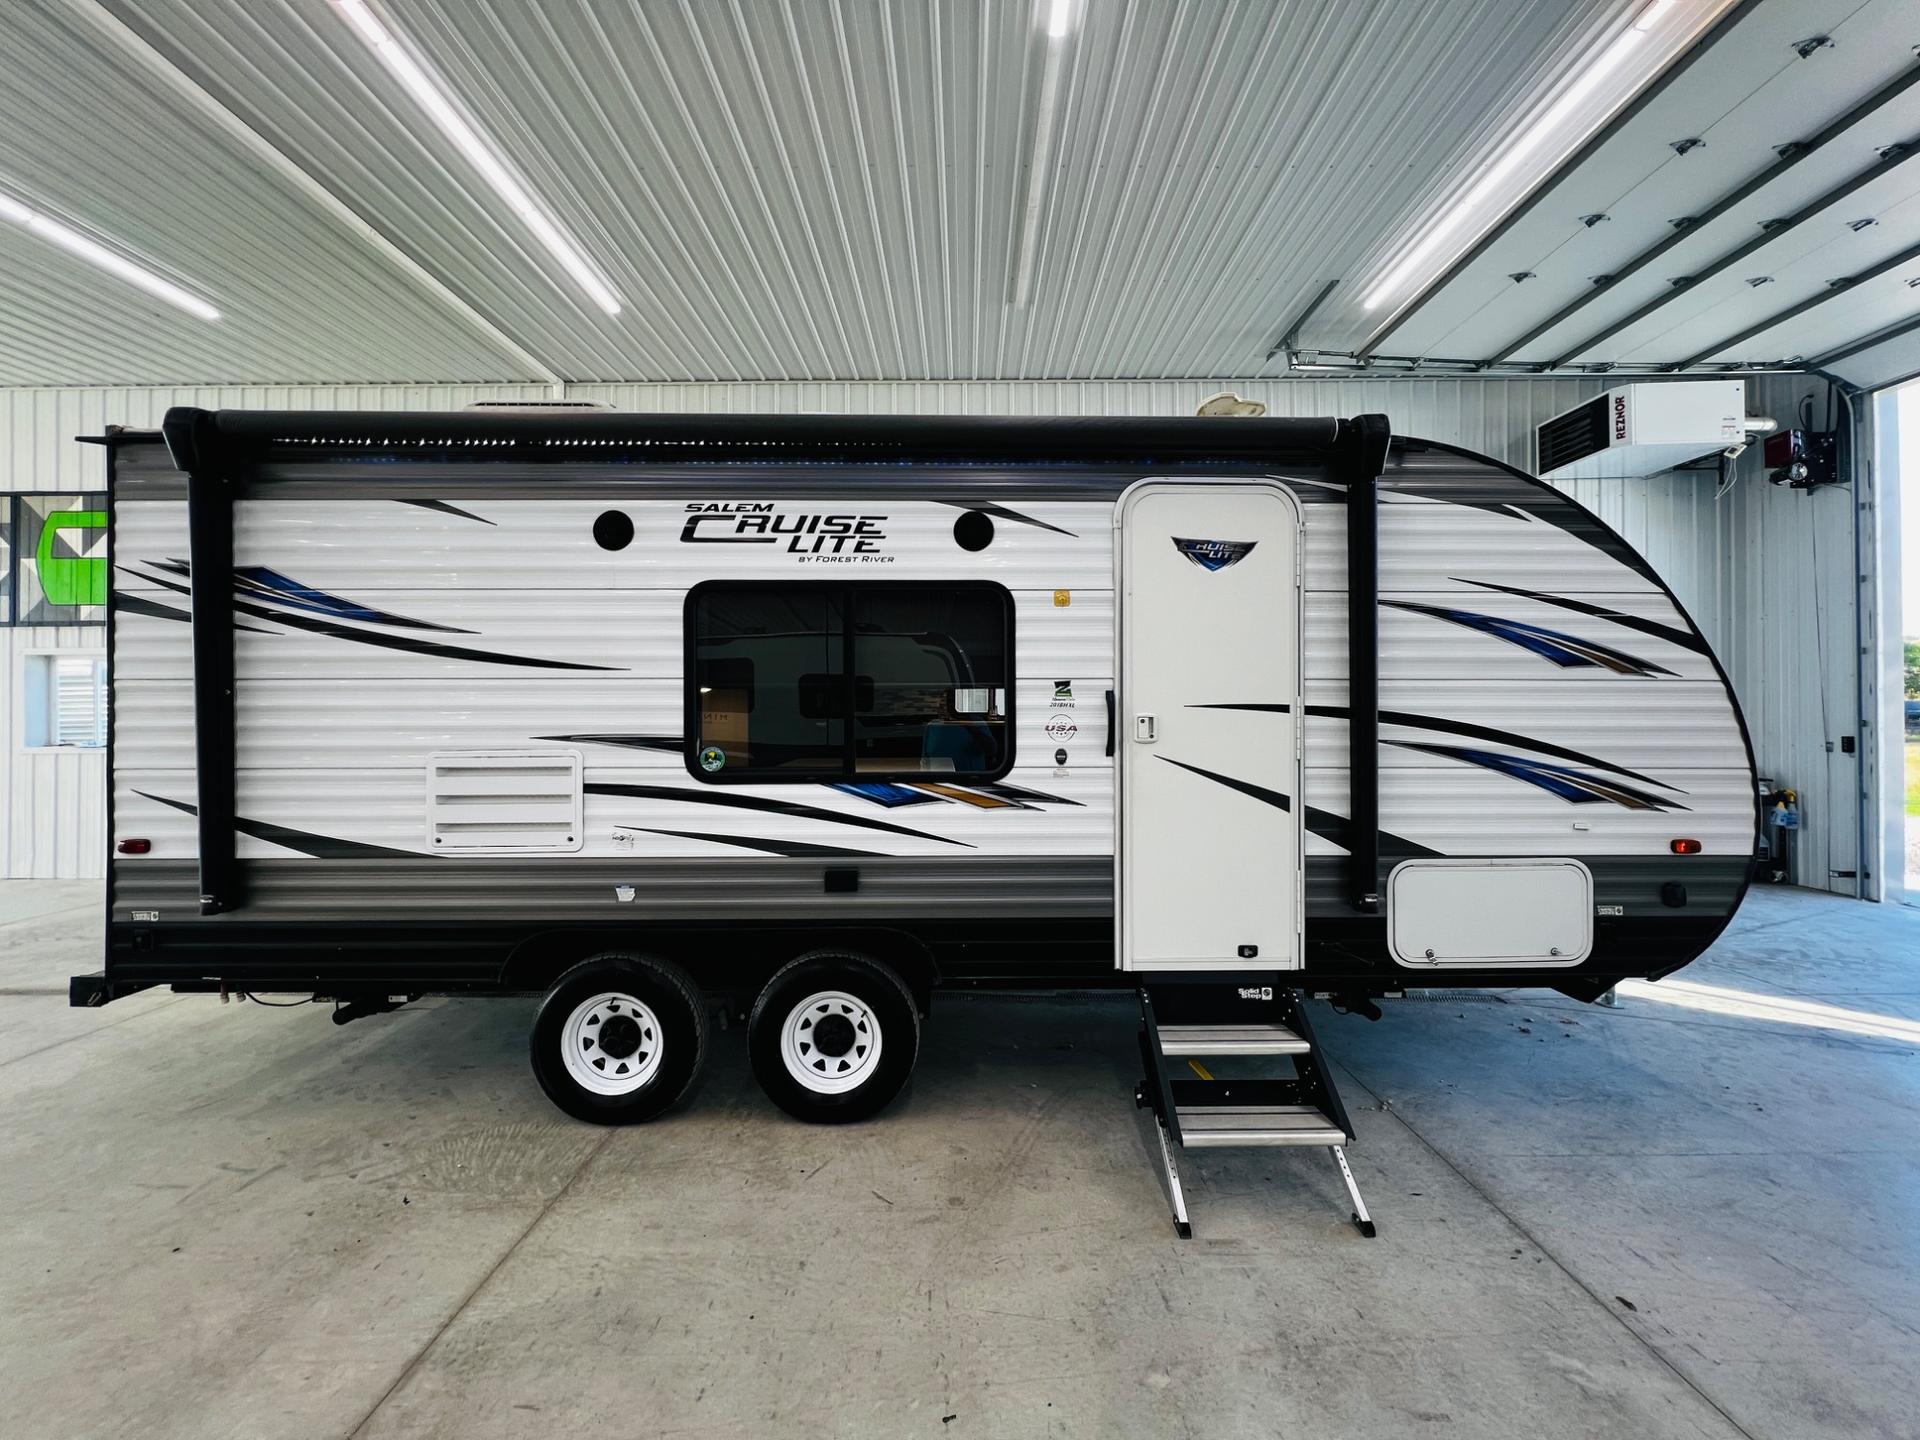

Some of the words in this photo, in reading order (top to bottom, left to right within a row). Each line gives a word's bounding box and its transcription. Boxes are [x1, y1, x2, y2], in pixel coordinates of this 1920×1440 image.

[1615, 396, 1625, 440] REZNOR
[684, 503, 775, 513] SALEM
[680, 514, 888, 543] CRUISE
[787, 535, 886, 553] LITE
[815, 555, 859, 563] FOREST
[861, 555, 895, 563] RIVER
